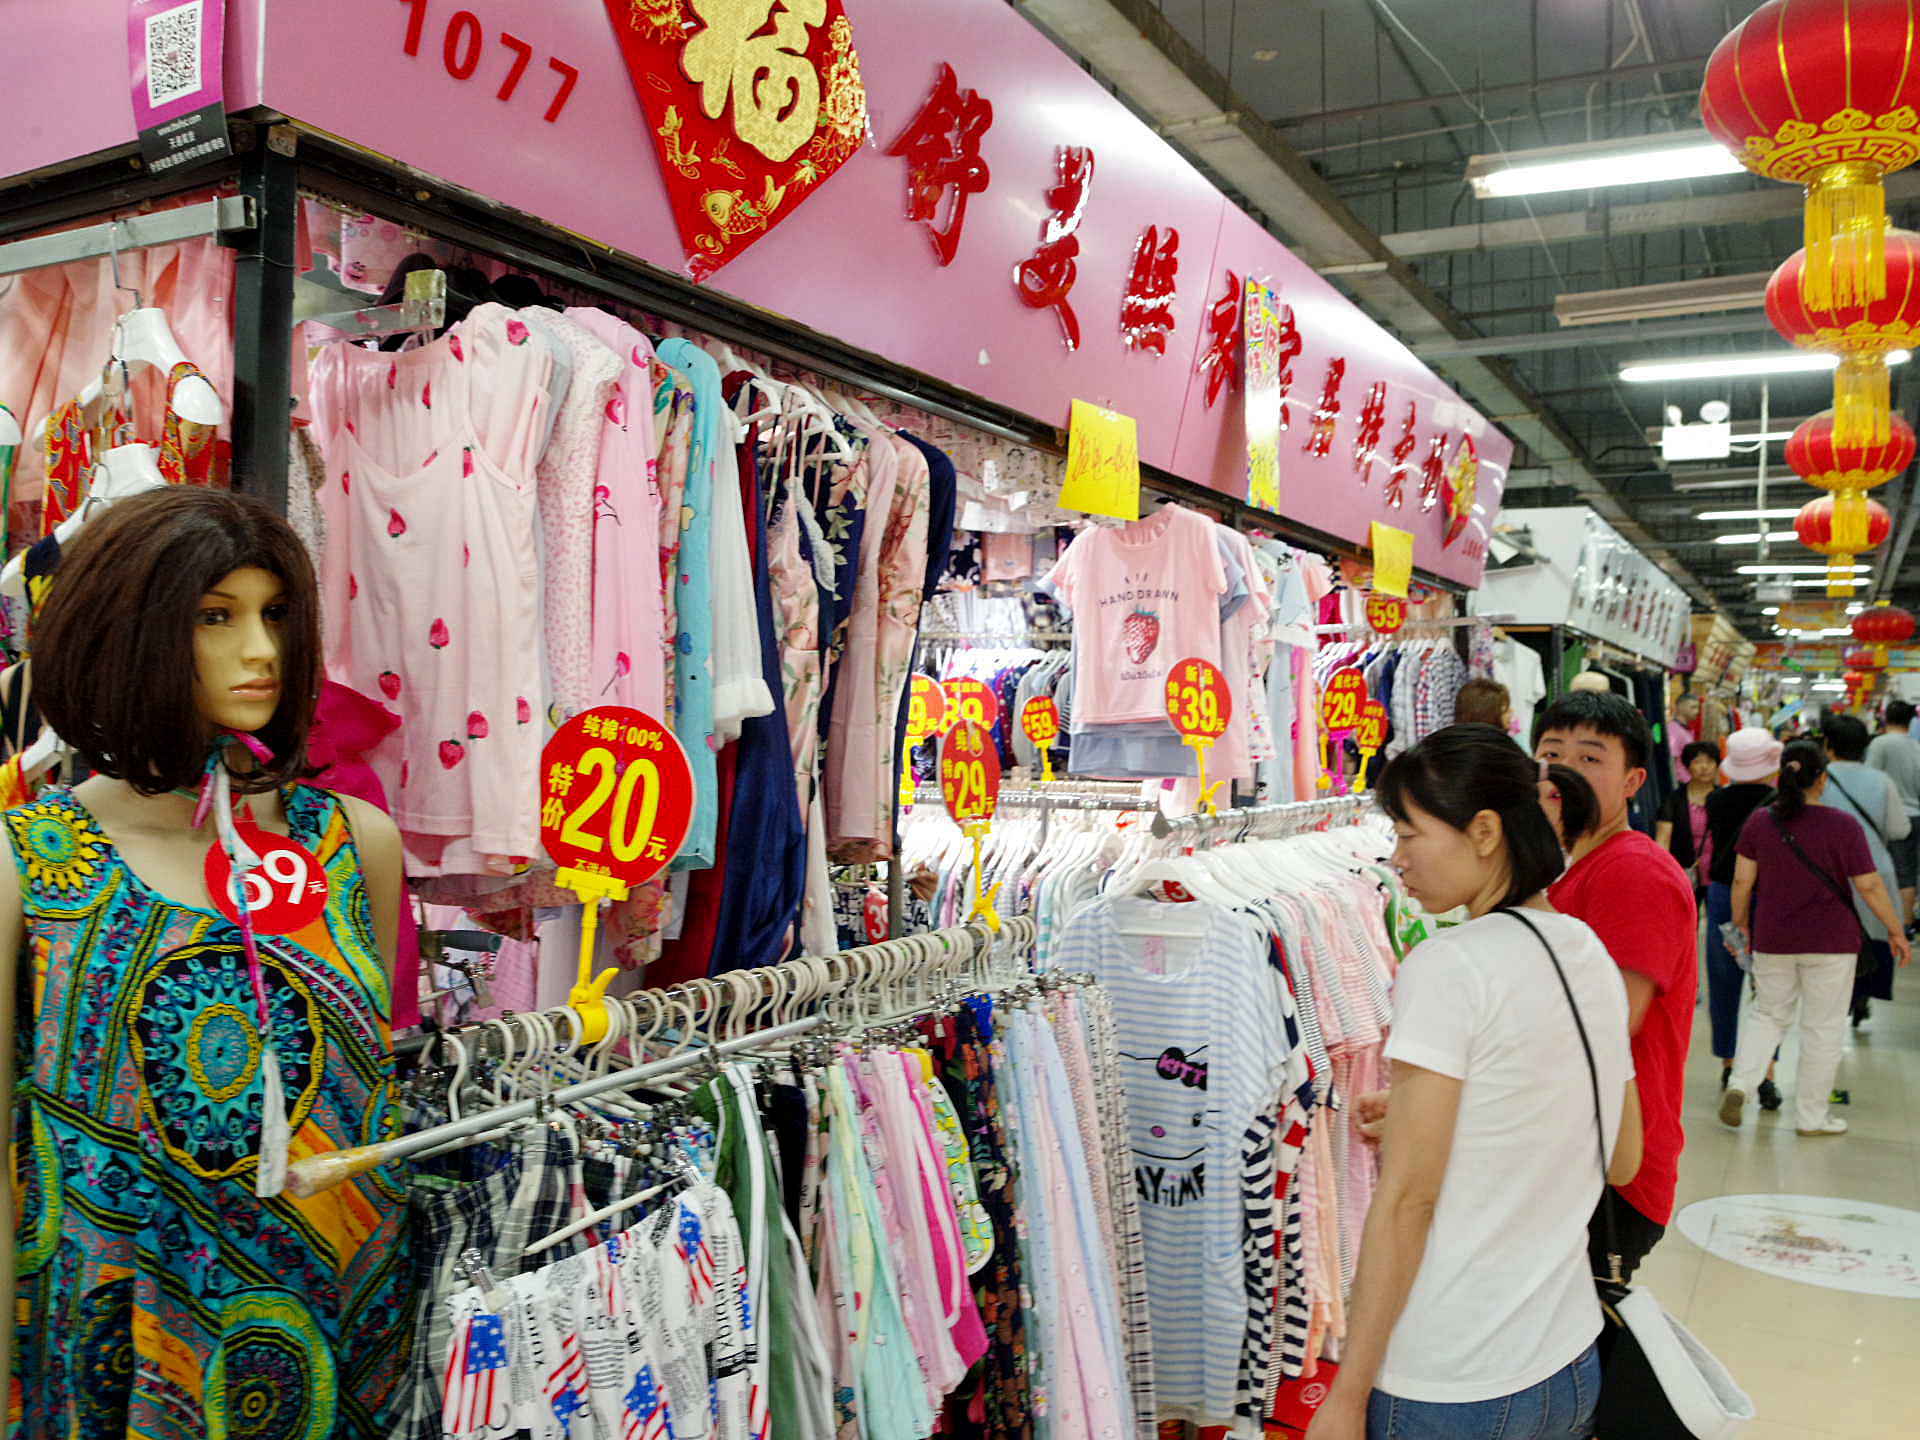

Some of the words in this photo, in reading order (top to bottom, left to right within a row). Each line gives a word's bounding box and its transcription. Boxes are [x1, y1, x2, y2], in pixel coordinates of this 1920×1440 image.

[402, 0, 579, 123] 1077
[1181, 685, 1217, 733] 39
[1328, 691, 1356, 729] 29
[541, 761, 575, 831] 特价
[559, 746, 660, 862] 20
[645, 835, 668, 862] 元
[953, 759, 987, 819] 29
